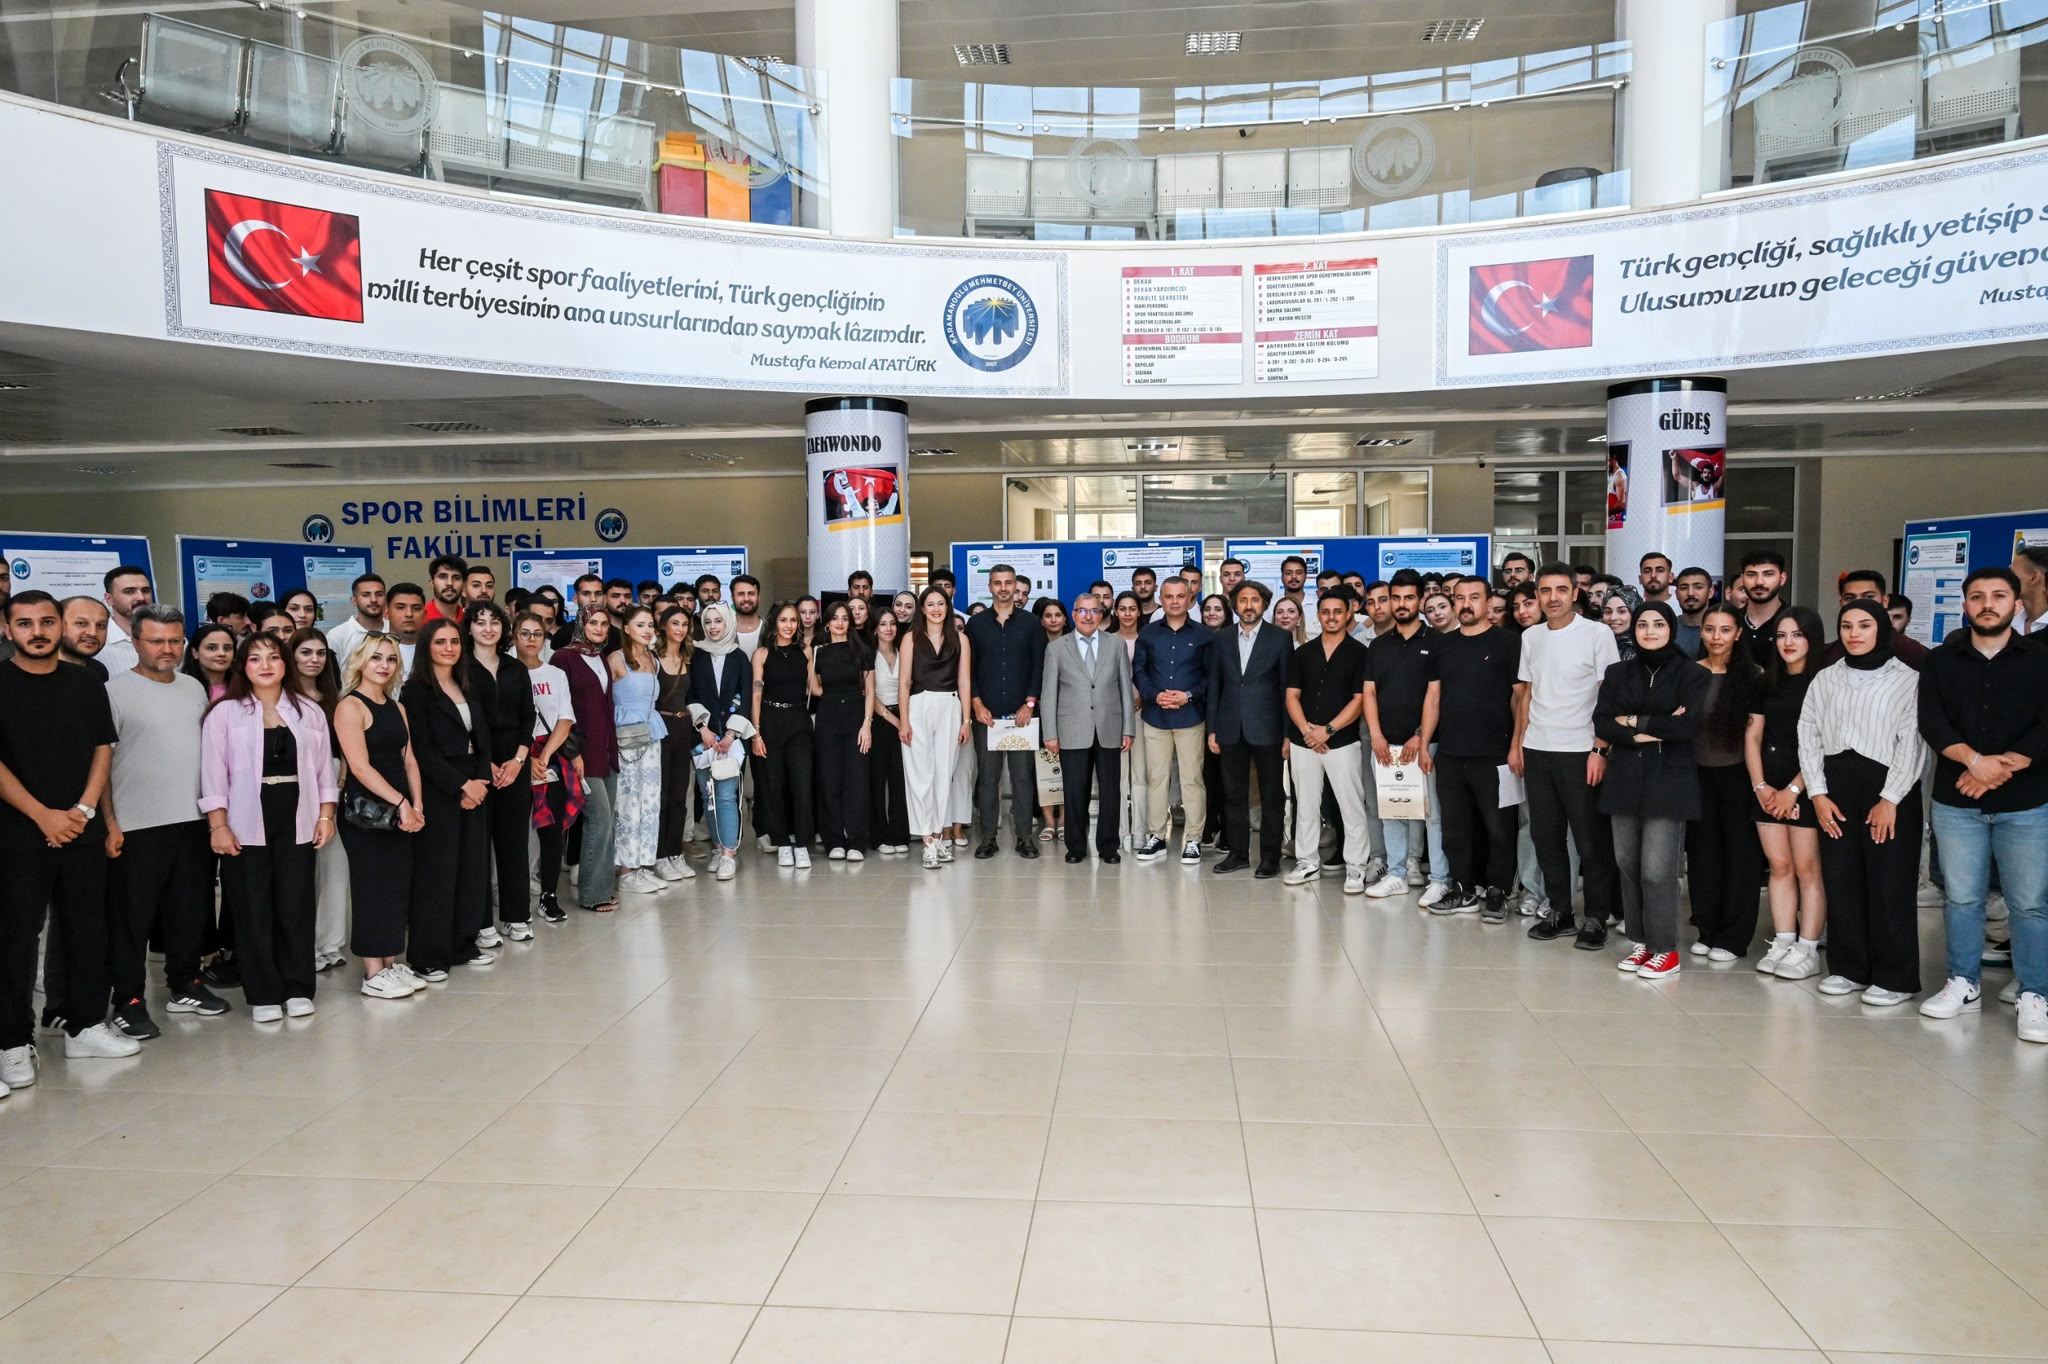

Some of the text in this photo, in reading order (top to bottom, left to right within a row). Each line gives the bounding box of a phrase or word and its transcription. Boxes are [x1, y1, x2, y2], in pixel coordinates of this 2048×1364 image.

[1620, 253, 1681, 279] Türk
[1682, 236, 1803, 279] gençliği,
[1808, 219, 1917, 258] sağlıklı
[1916, 202, 2034, 248] yetişip
[1179, 266, 1195, 276] KAT
[1312, 260, 1329, 271] KAT
[418, 247, 885, 316] Her çeşit spor faaliyetlerini, Türk gençliğinin
[1620, 279, 1797, 314] Ulusumuzun
[1798, 255, 1933, 301] geleceği
[1979, 284, 2048, 305] Musta
[367, 278, 927, 345] milli terbiyesinin ana unsurlarından saymak lâzımdır.
[946, 285, 969, 345] KARAMANOĞLU
[968, 277, 1018, 292] MEHMETBEY
[1164, 334, 1200, 344] BODRUM
[1323, 328, 1339, 339] KAT
[750, 353, 937, 372] Mustafa Kemal ATATÜRK
[1659, 408, 1711, 435] GÜREŞ
[341, 491, 586, 526] SPOR BİLİMLERİ
[387, 528, 542, 560] FAKÜLTESİ
[532, 681, 552, 697] AVİ
